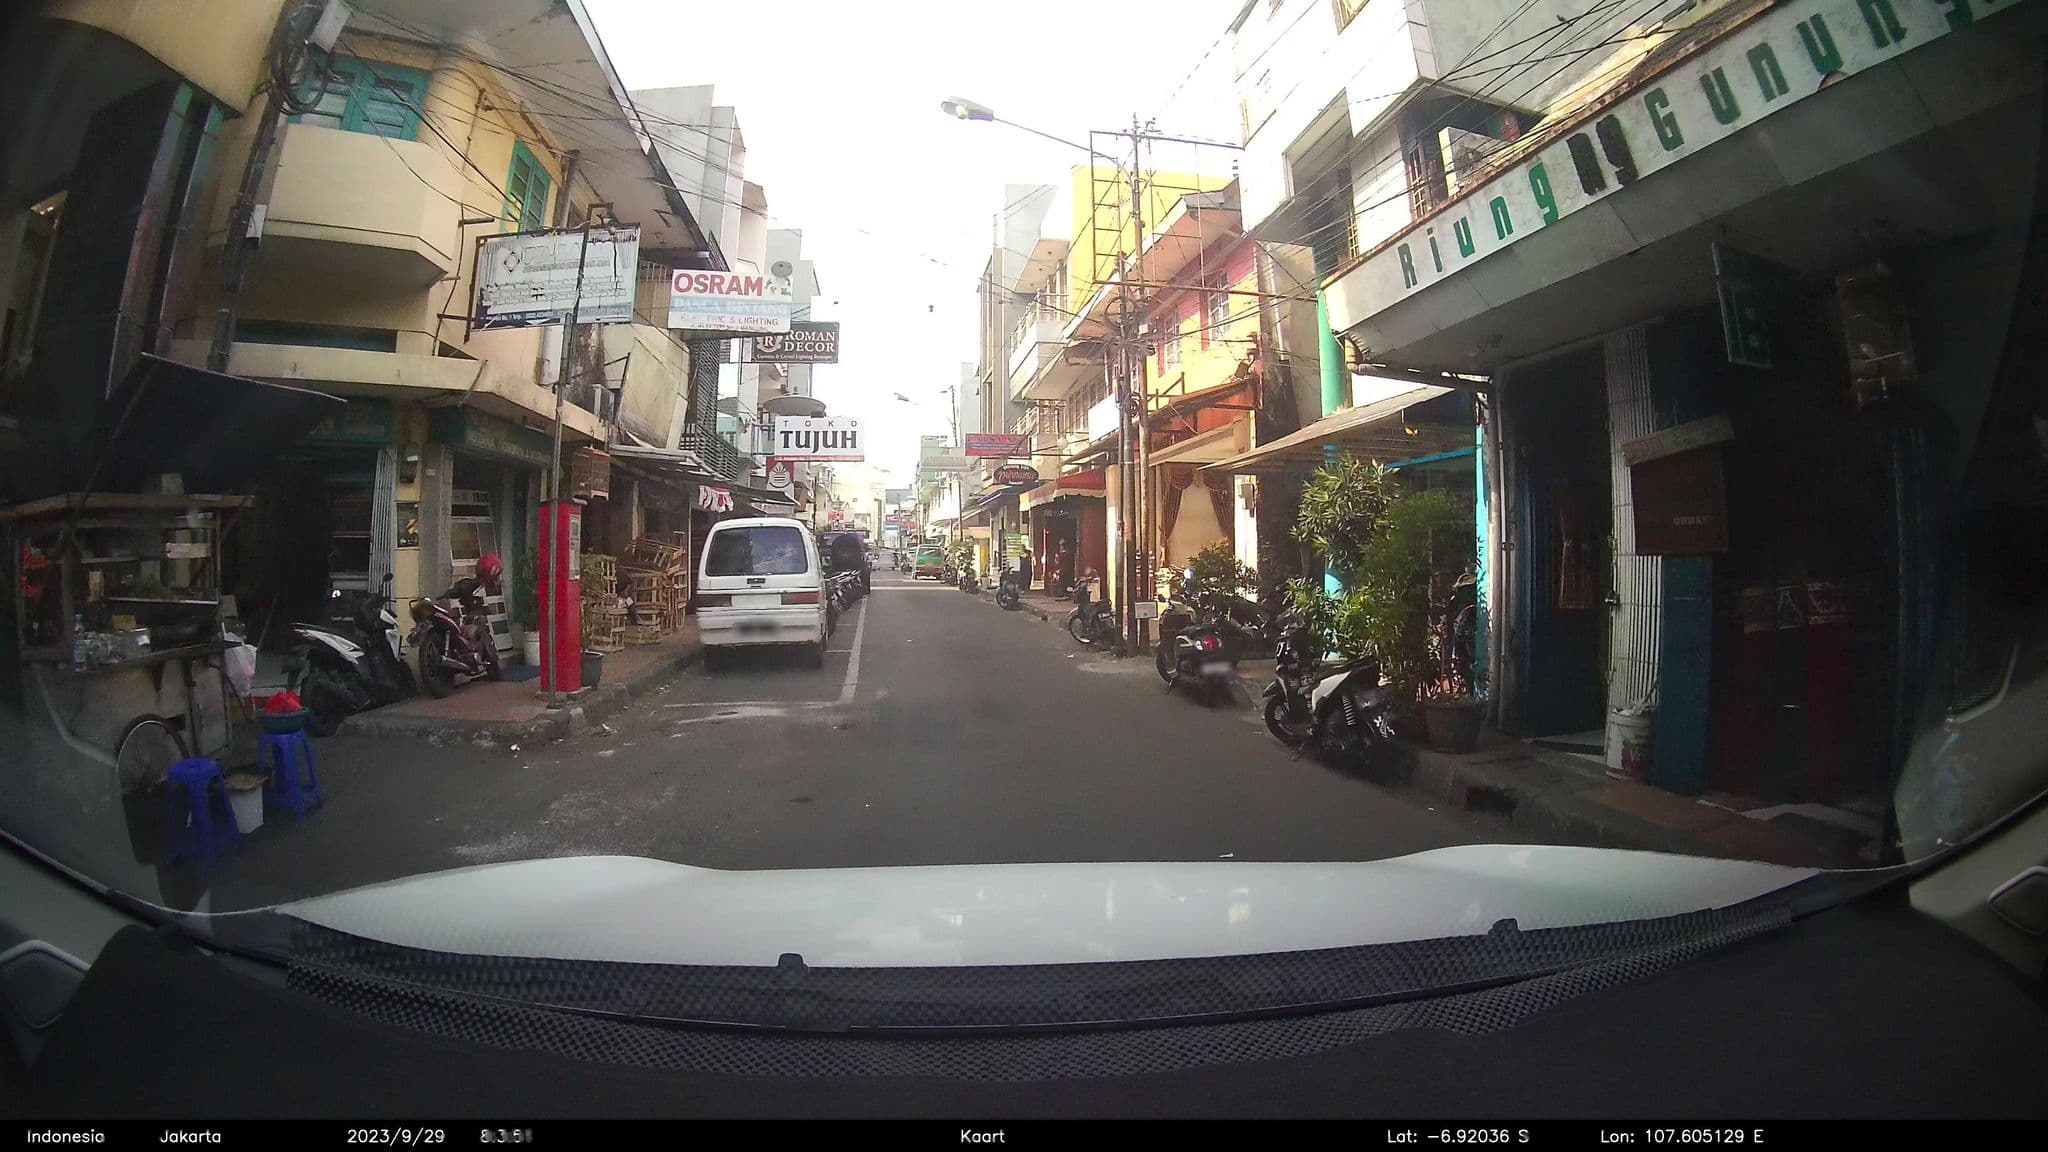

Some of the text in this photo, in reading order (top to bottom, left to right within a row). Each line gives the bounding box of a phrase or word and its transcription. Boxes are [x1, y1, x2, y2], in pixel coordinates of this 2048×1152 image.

[674, 272, 764, 297] OSRAM
[680, 313, 727, 323] ELETRIC
[739, 316, 779, 326] LIGHTING
[785, 329, 835, 342] ROMAN
[784, 342, 835, 352] DECOR
